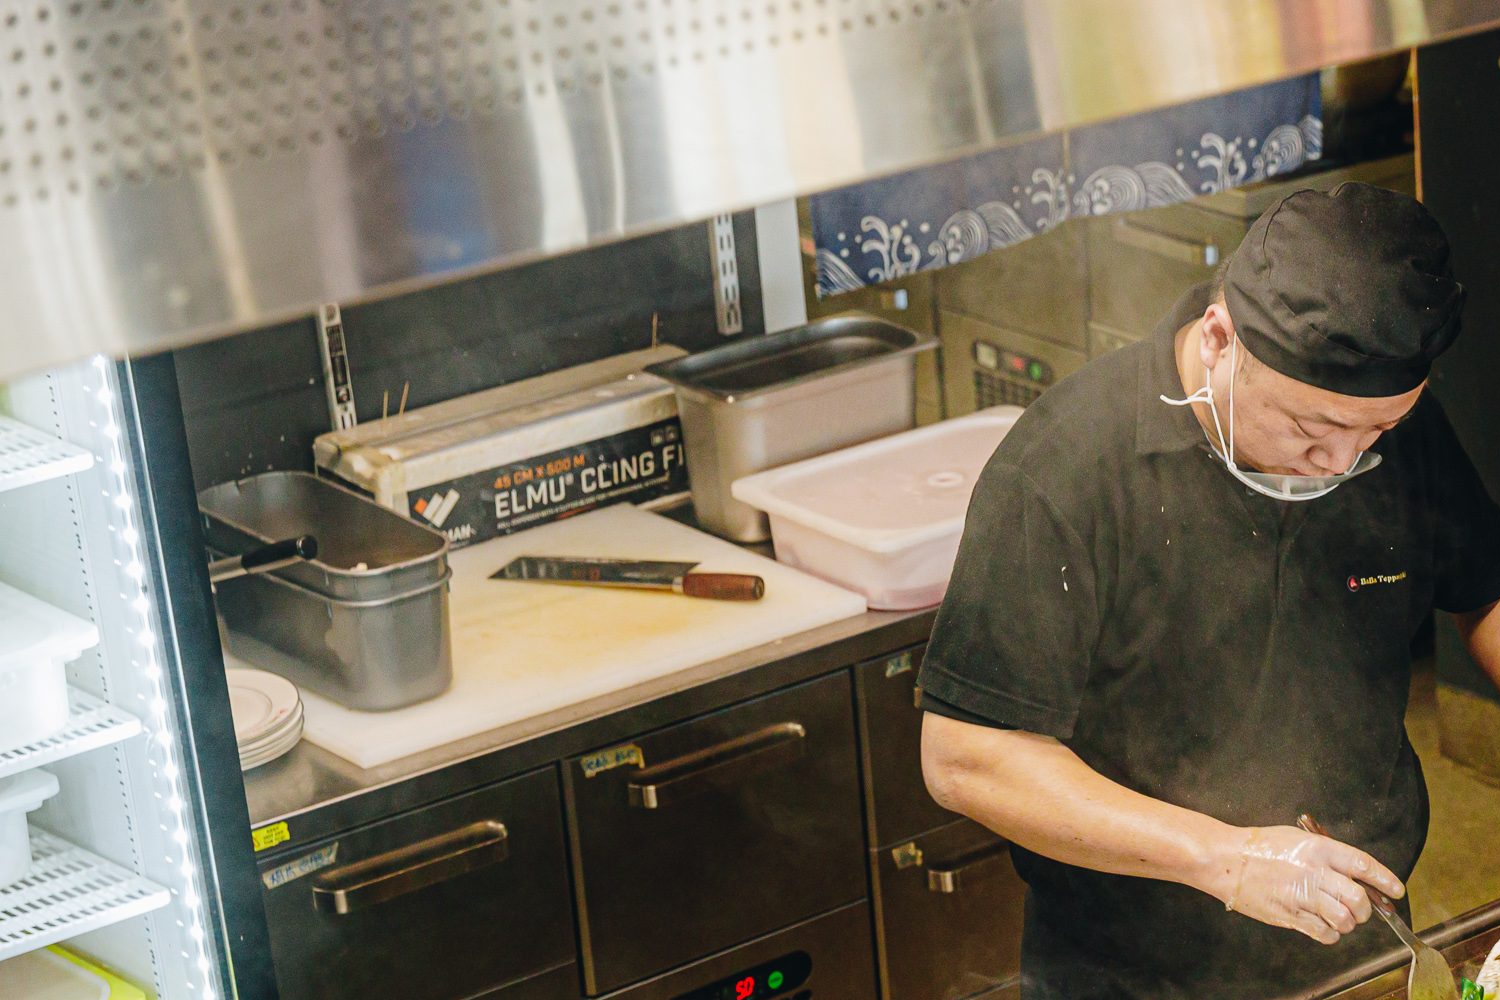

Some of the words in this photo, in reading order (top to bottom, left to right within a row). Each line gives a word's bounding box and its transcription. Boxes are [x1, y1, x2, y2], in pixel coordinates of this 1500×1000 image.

[513, 467, 534, 486] CM
[573, 452, 586, 468] M
[580, 450, 655, 495] CLING
